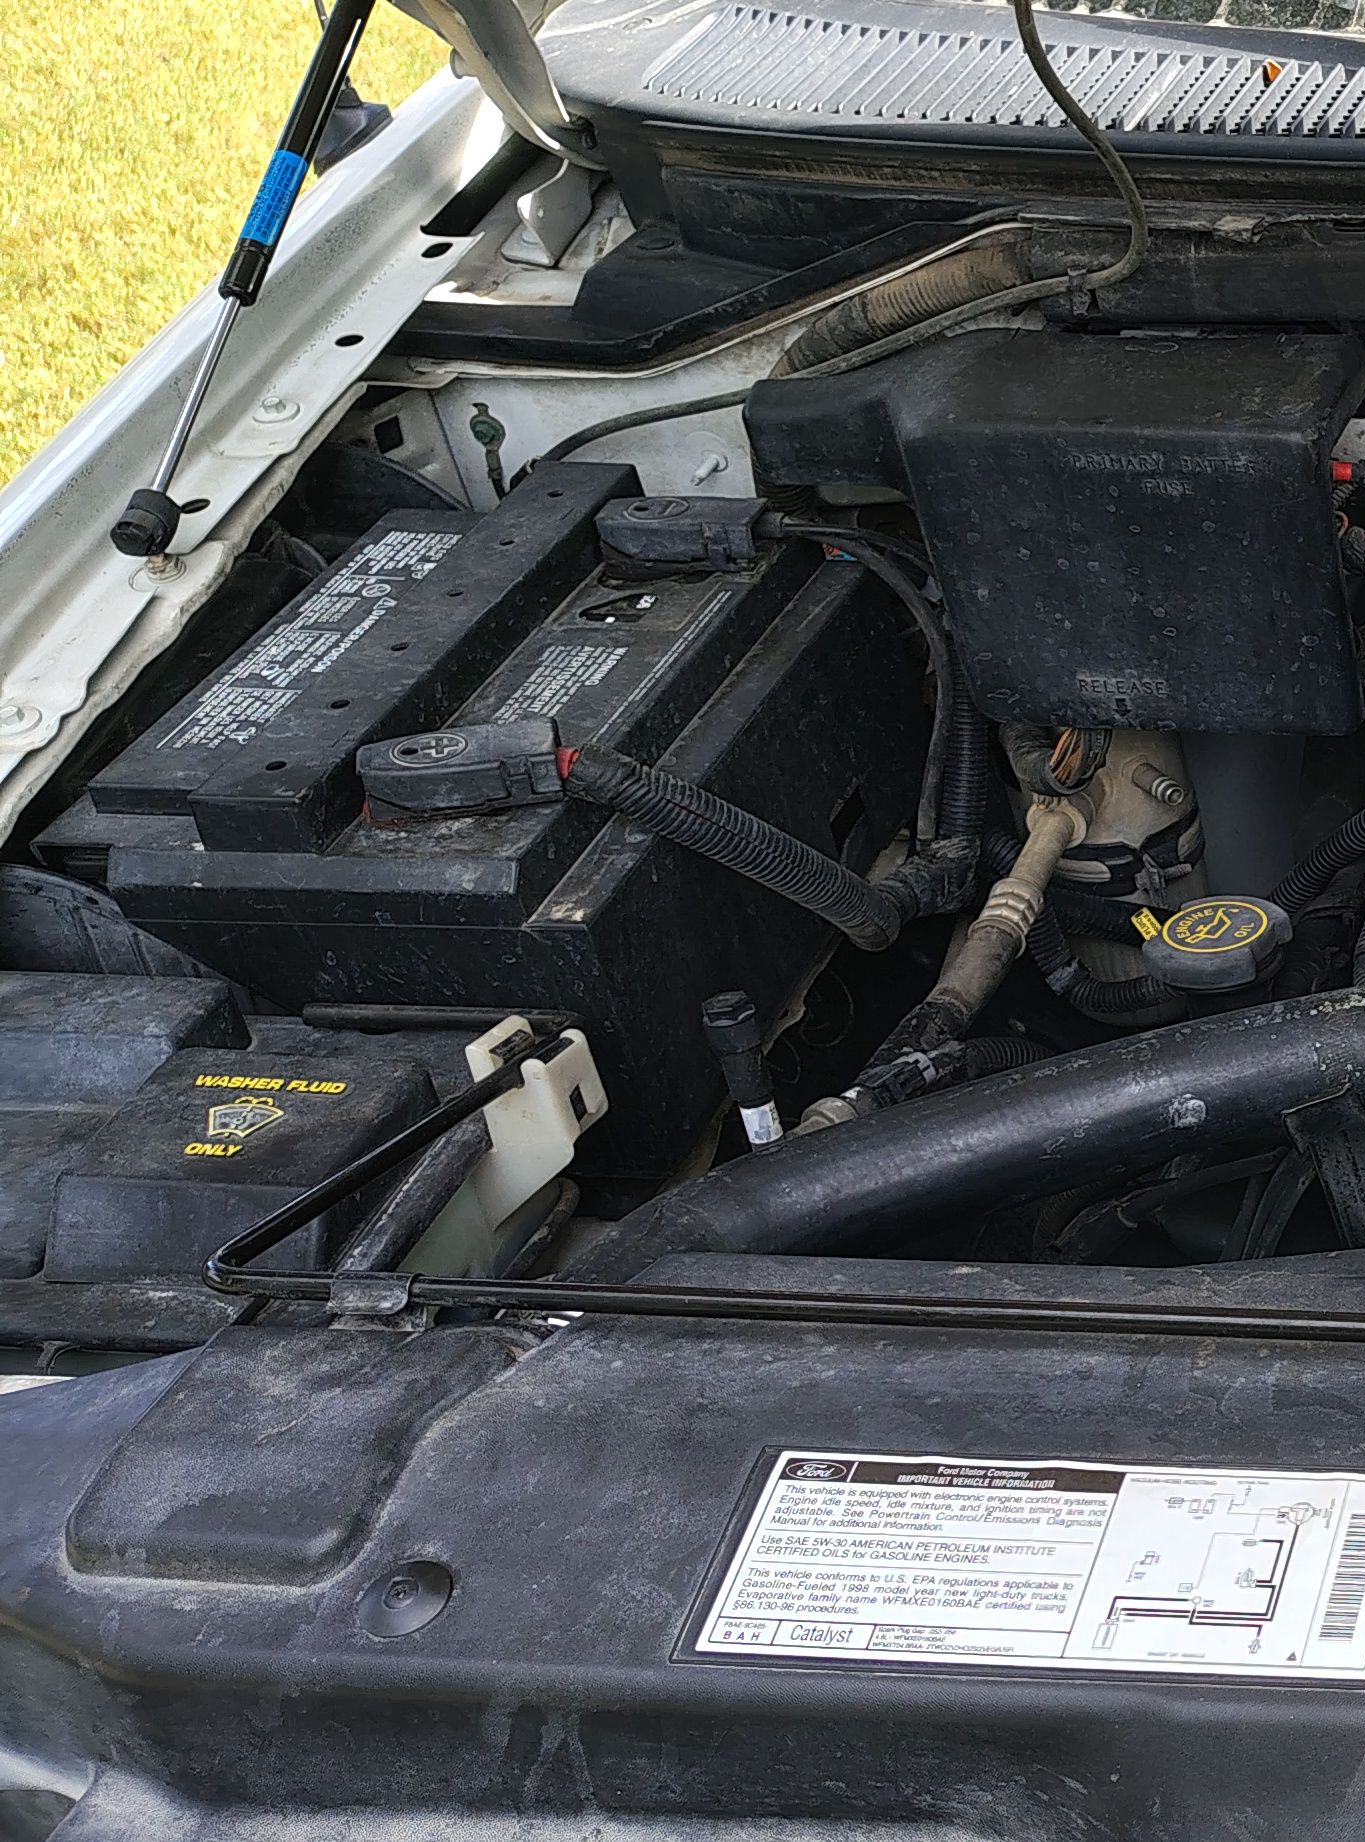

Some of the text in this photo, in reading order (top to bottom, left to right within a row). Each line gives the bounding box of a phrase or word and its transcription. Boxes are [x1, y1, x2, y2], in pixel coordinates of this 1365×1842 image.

[1072, 453, 1165, 474] PRIMARY
[1142, 479, 1194, 496] FUSE
[588, 645, 630, 687] WARNING
[1077, 677, 1170, 696] RELEASE
[1175, 908, 1215, 939] ENGINE
[1234, 921, 1255, 938] OIL
[195, 1075, 346, 1094] WASHER FLUID
[184, 1143, 242, 1157] ONLY
[797, 1463, 836, 1478] Ford
[937, 1466, 959, 1475] Ford
[987, 1468, 1030, 1479] Company
[897, 1474, 1055, 1488] IMPORTANT VEHICLE INFORMATION
[780, 1495, 818, 1507] Engine
[822, 1496, 841, 1506] idle
[845, 1497, 881, 1509] speed,
[887, 1499, 906, 1508] idle
[910, 1501, 955, 1512] mixture,
[959, 1502, 981, 1512] and
[985, 1504, 1025, 1516] ignition
[1029, 1506, 1062, 1517] timing
[1088, 1508, 1107, 1517] not
[784, 1485, 1109, 1508] This vehicle is equipped with electronic engine control systems.
[770, 1515, 943, 1531] Manual for additional information.
[774, 1506, 1102, 1528] adjustable. See Powertrain Control/Emissions Diagnosis
[756, 1546, 990, 1564] CERTIFIED OILS for GASOLINE ENGINES.
[761, 1535, 1056, 1556] Use SAE 5W-30 AMERICAN PETROLEUM INSTITUTE
[748, 1567, 1074, 1592] This vehicle conforms to U.S. EPA regulations applicable to
[742, 1578, 1067, 1602] Gasoline-Fueled 1998 model year new light-duty trucks.
[738, 1589, 804, 1601] Evaporative
[808, 1592, 843, 1604] family
[845, 1595, 877, 1604] name
[985, 1600, 1031, 1611] certified
[1034, 1602, 1066, 1614] using
[796, 1603, 859, 1615] procedures.
[790, 1625, 854, 1645] Catalyst
